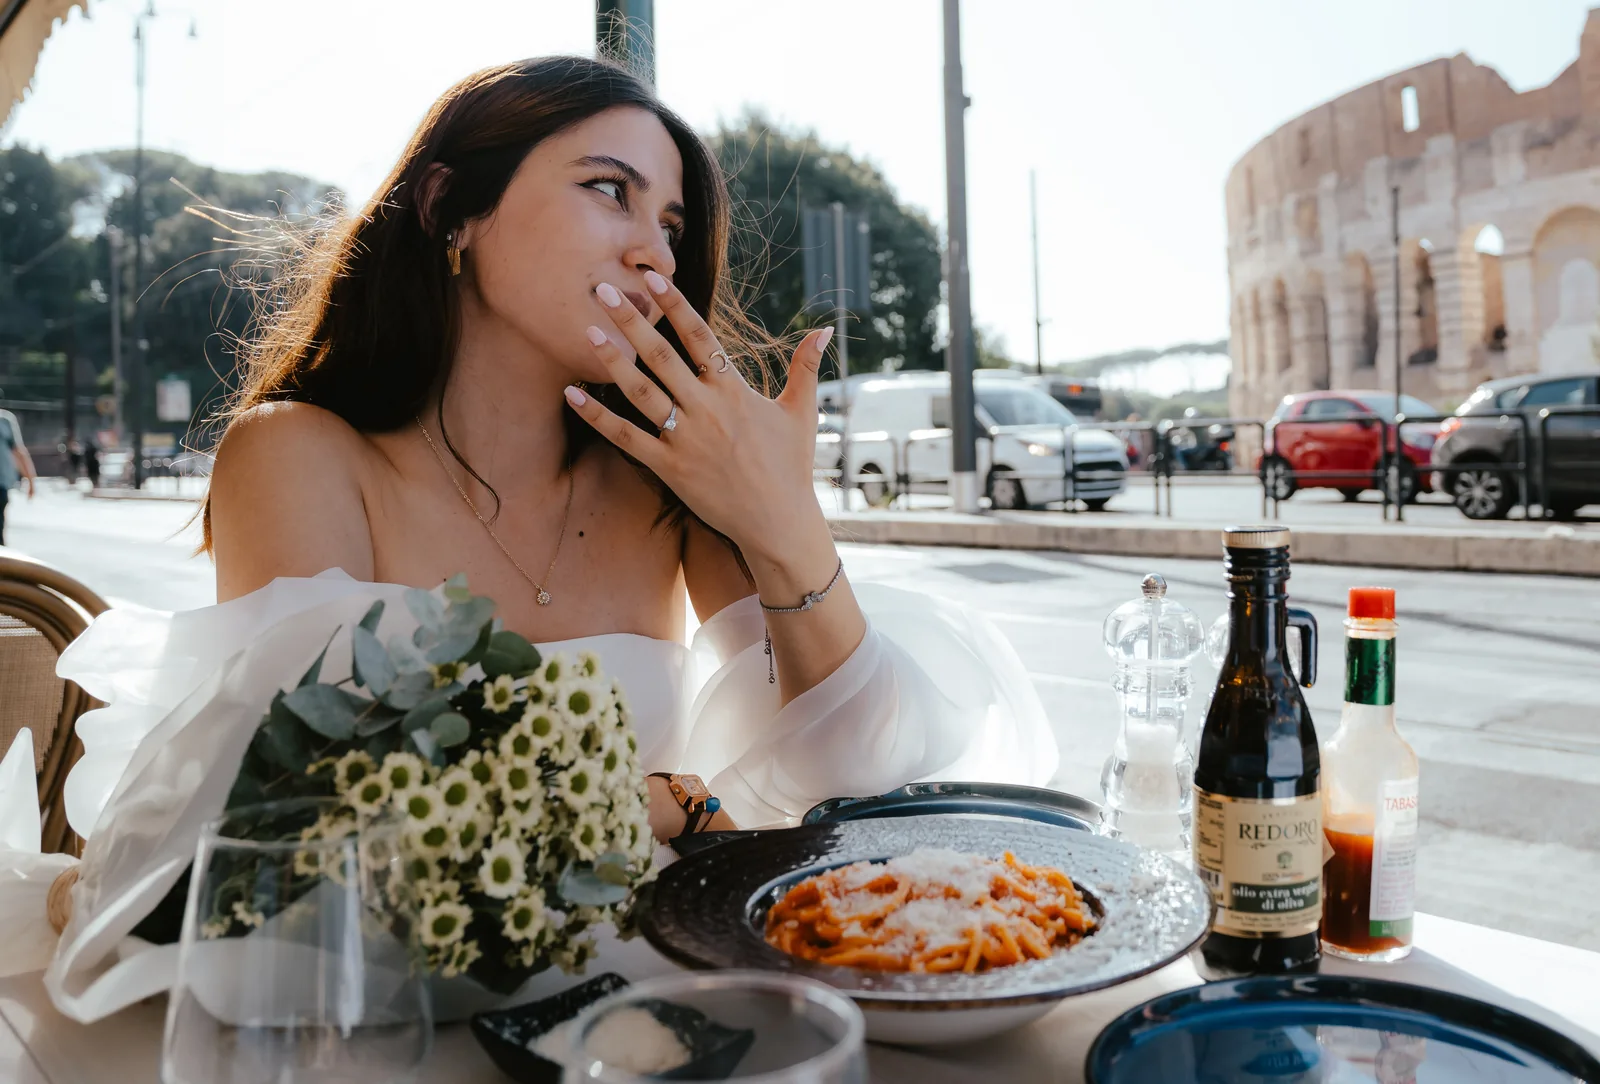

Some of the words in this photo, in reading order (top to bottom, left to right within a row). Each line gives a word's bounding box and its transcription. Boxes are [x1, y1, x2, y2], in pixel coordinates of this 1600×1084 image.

[1238, 818, 1317, 845] REDORO
[1232, 885, 1257, 898] olio
[1259, 887, 1291, 899] extra
[1261, 898, 1275, 911] di
[1277, 897, 1305, 910] oliva
